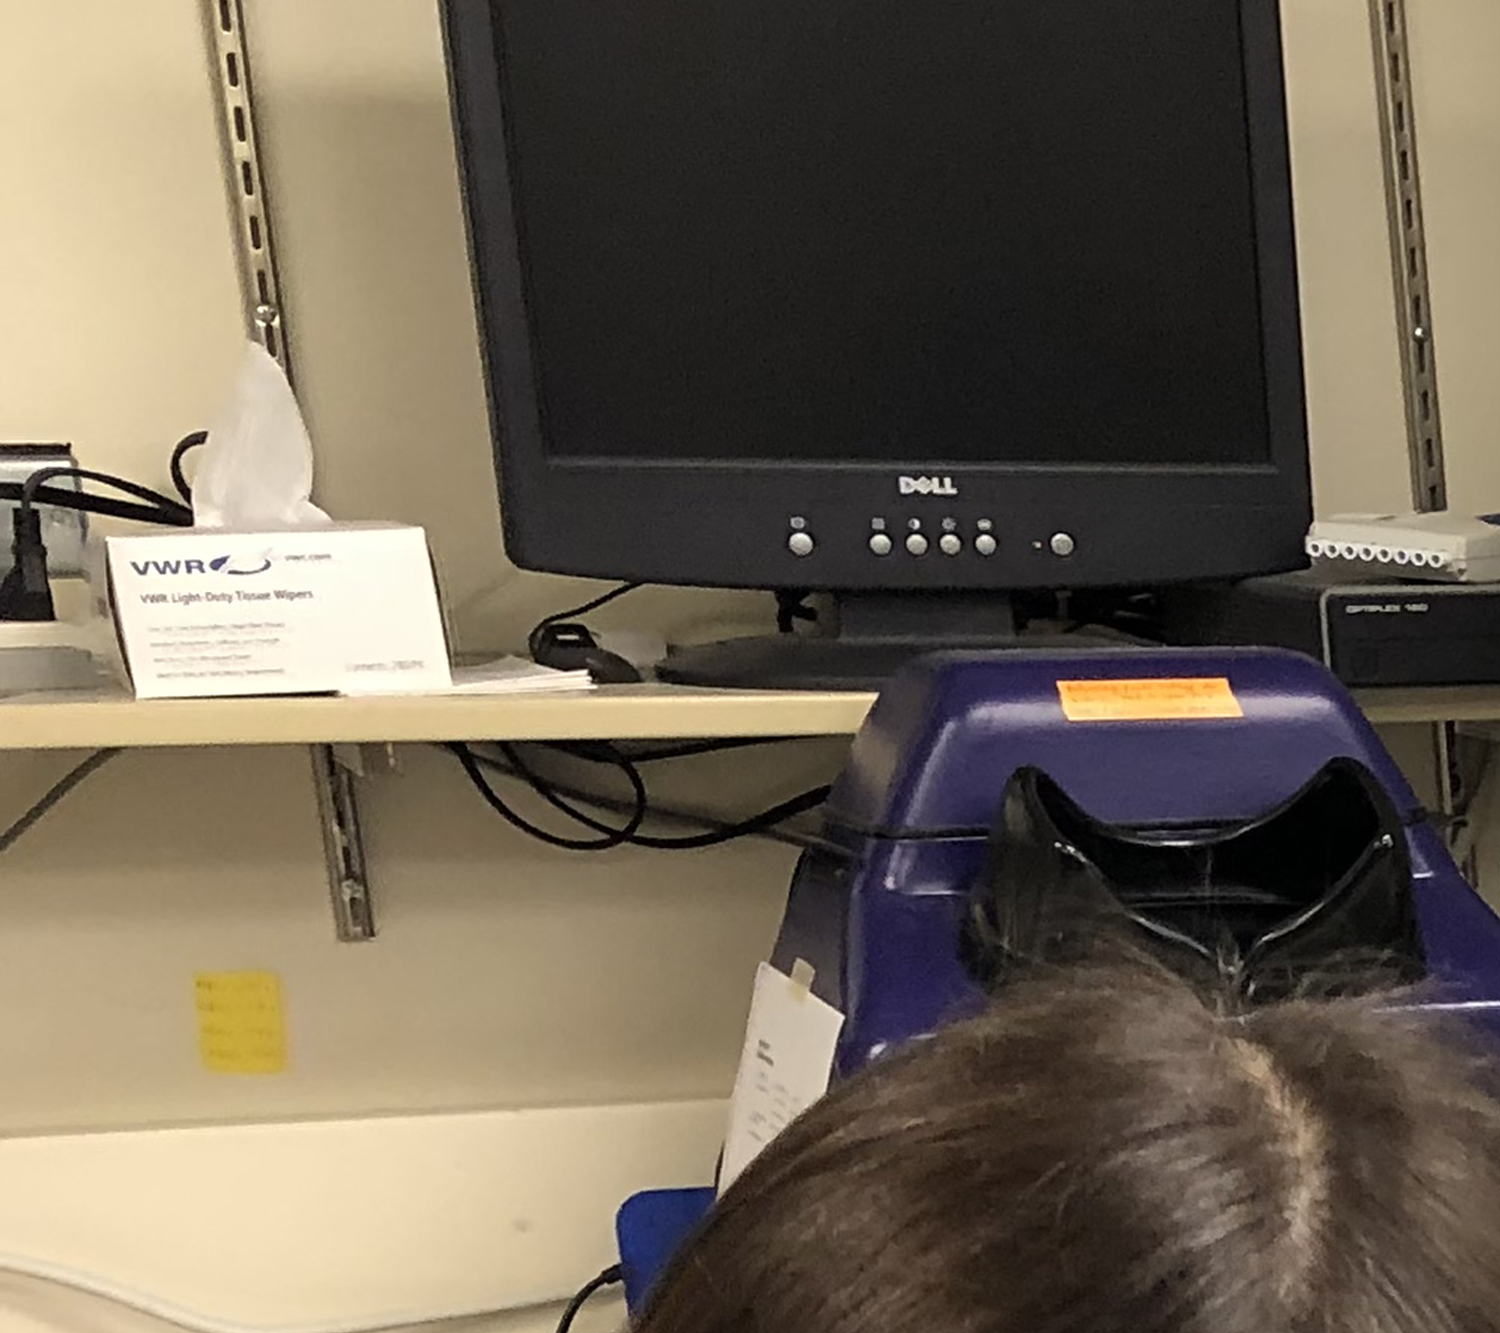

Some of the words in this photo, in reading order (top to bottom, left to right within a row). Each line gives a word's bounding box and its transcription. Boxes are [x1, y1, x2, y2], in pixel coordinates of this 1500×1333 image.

[898, 475, 958, 495] DELL
[130, 559, 206, 576] VWR
[273, 588, 314, 601] Wipers
